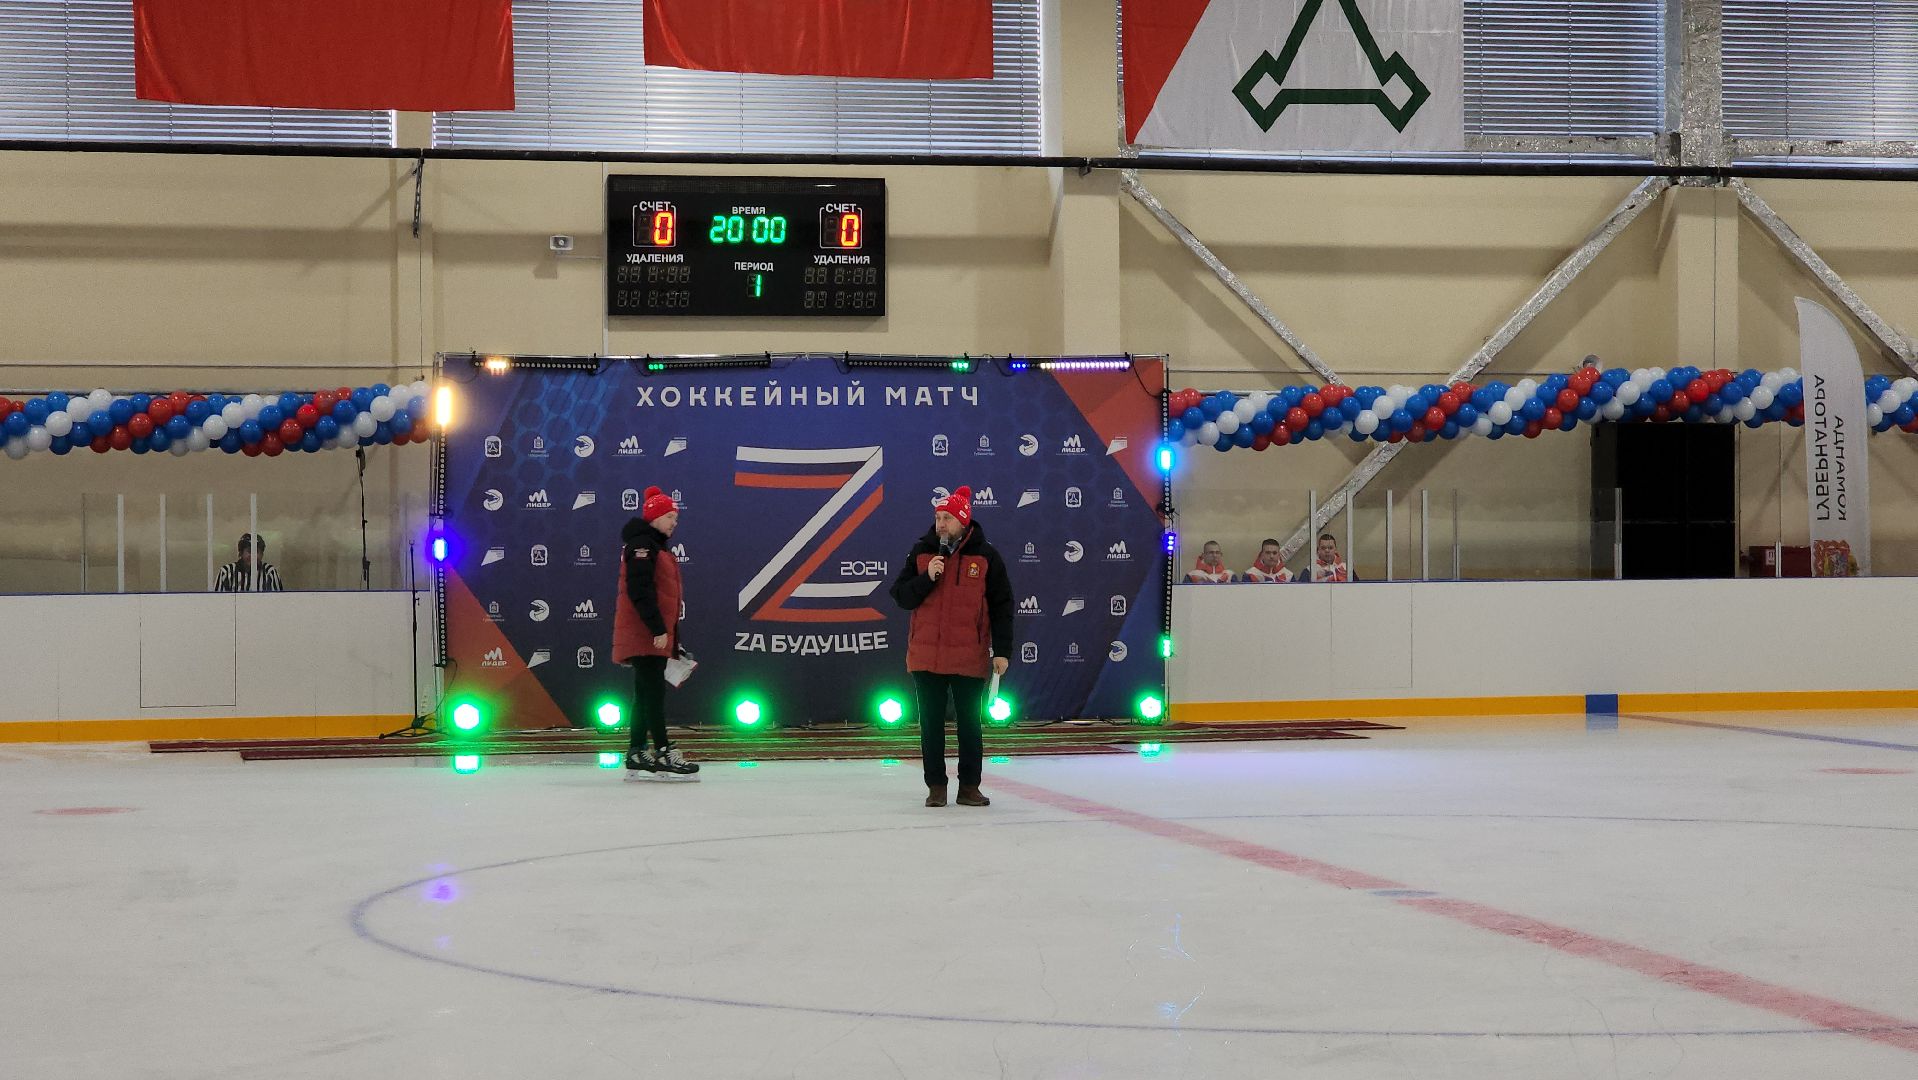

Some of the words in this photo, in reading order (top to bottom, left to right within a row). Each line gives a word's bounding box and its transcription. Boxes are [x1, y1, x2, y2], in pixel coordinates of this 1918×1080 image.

[639, 201, 671, 212] СЧЕТ
[732, 206, 766, 215] ВРЕМЯ
[826, 203, 857, 213] СЧЕТ
[654, 212, 673, 245] 0
[841, 214, 860, 247] 0
[626, 253, 684, 264] УДАЛЕНИЯ
[813, 255, 871, 265] УДАЛЕНИЯ
[734, 262, 774, 272] ПЕРИОД
[755, 274, 762, 297] 1
[636, 380, 865, 407] ХОККЕЙНЫЙ
[885, 387, 978, 406] МАТЧ
[840, 561, 888, 576] 2024
[771, 631, 889, 656] БУДУЩЕЕ
